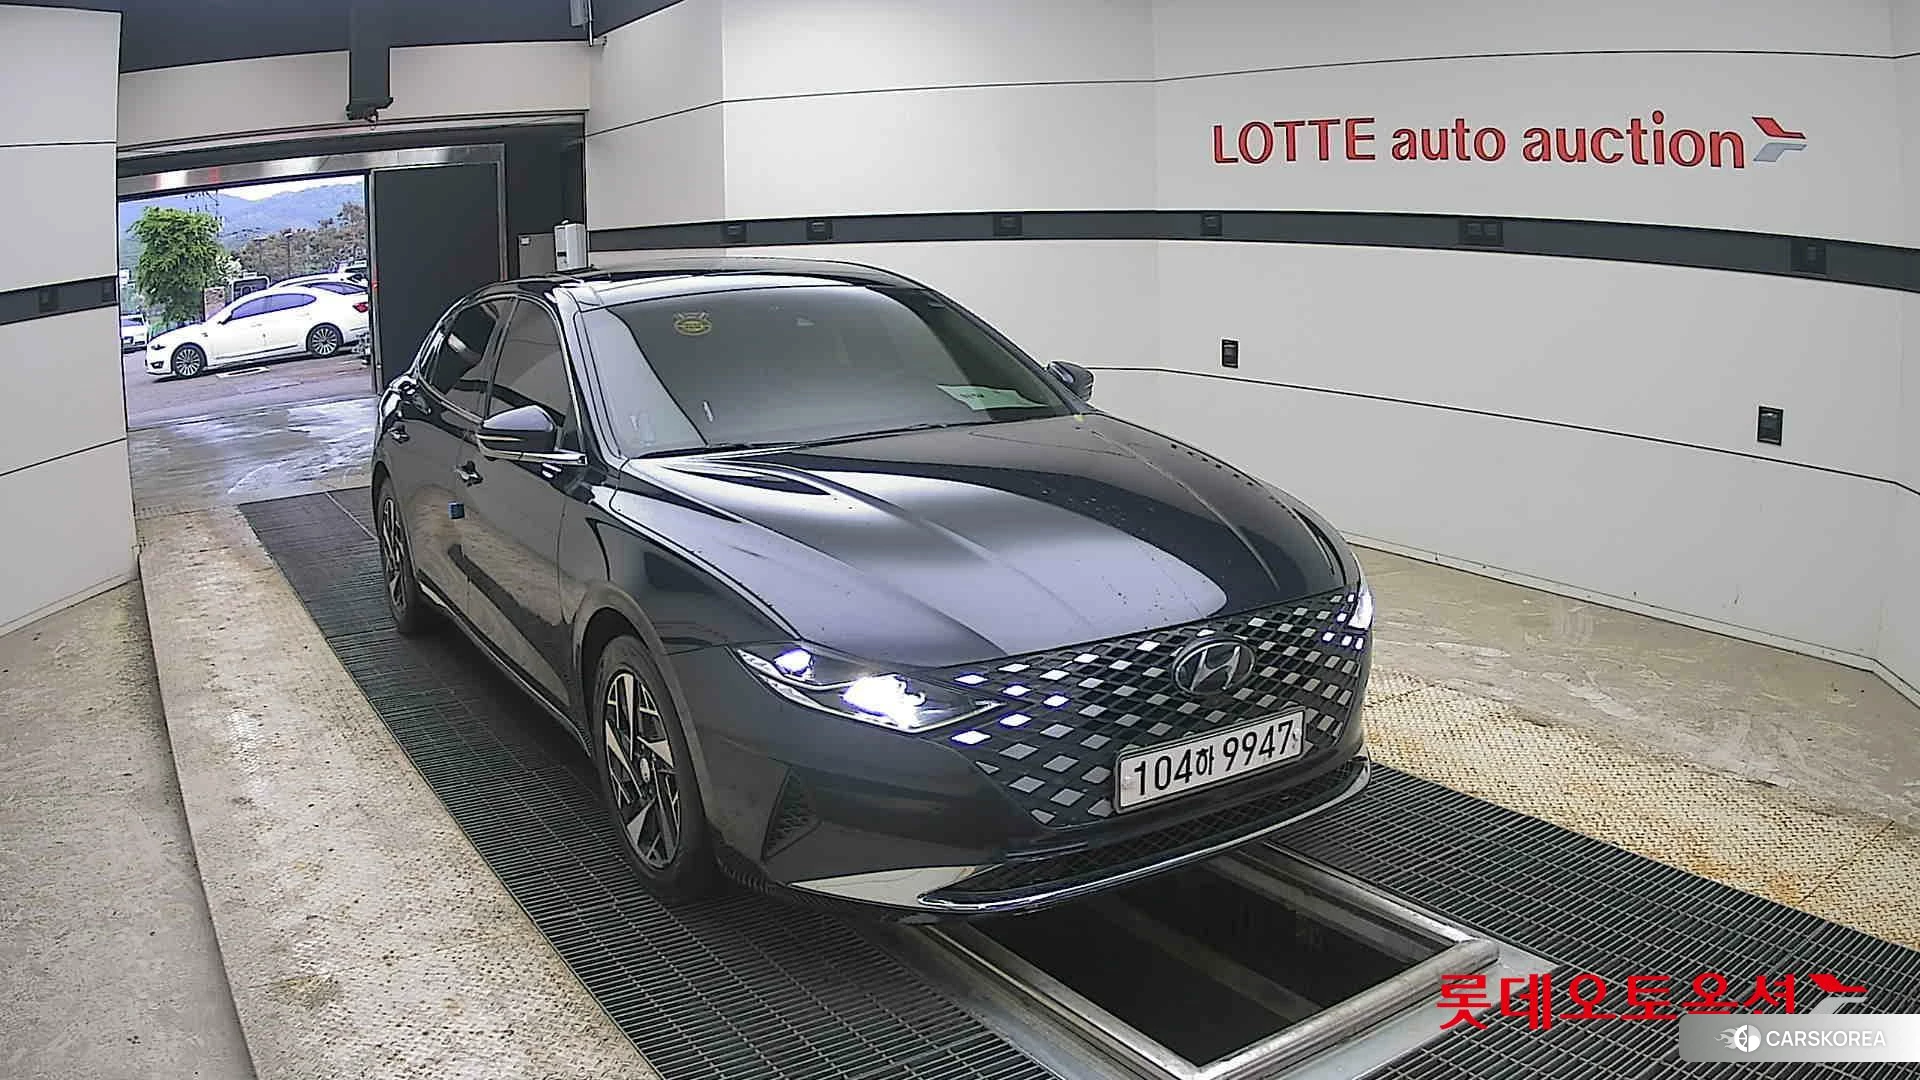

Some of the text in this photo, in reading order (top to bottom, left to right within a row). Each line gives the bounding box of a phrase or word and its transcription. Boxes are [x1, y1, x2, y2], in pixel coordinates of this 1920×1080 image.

[1212, 109, 1746, 169] LOTTE auto auction
[1134, 719, 1294, 796] 104하 9947
